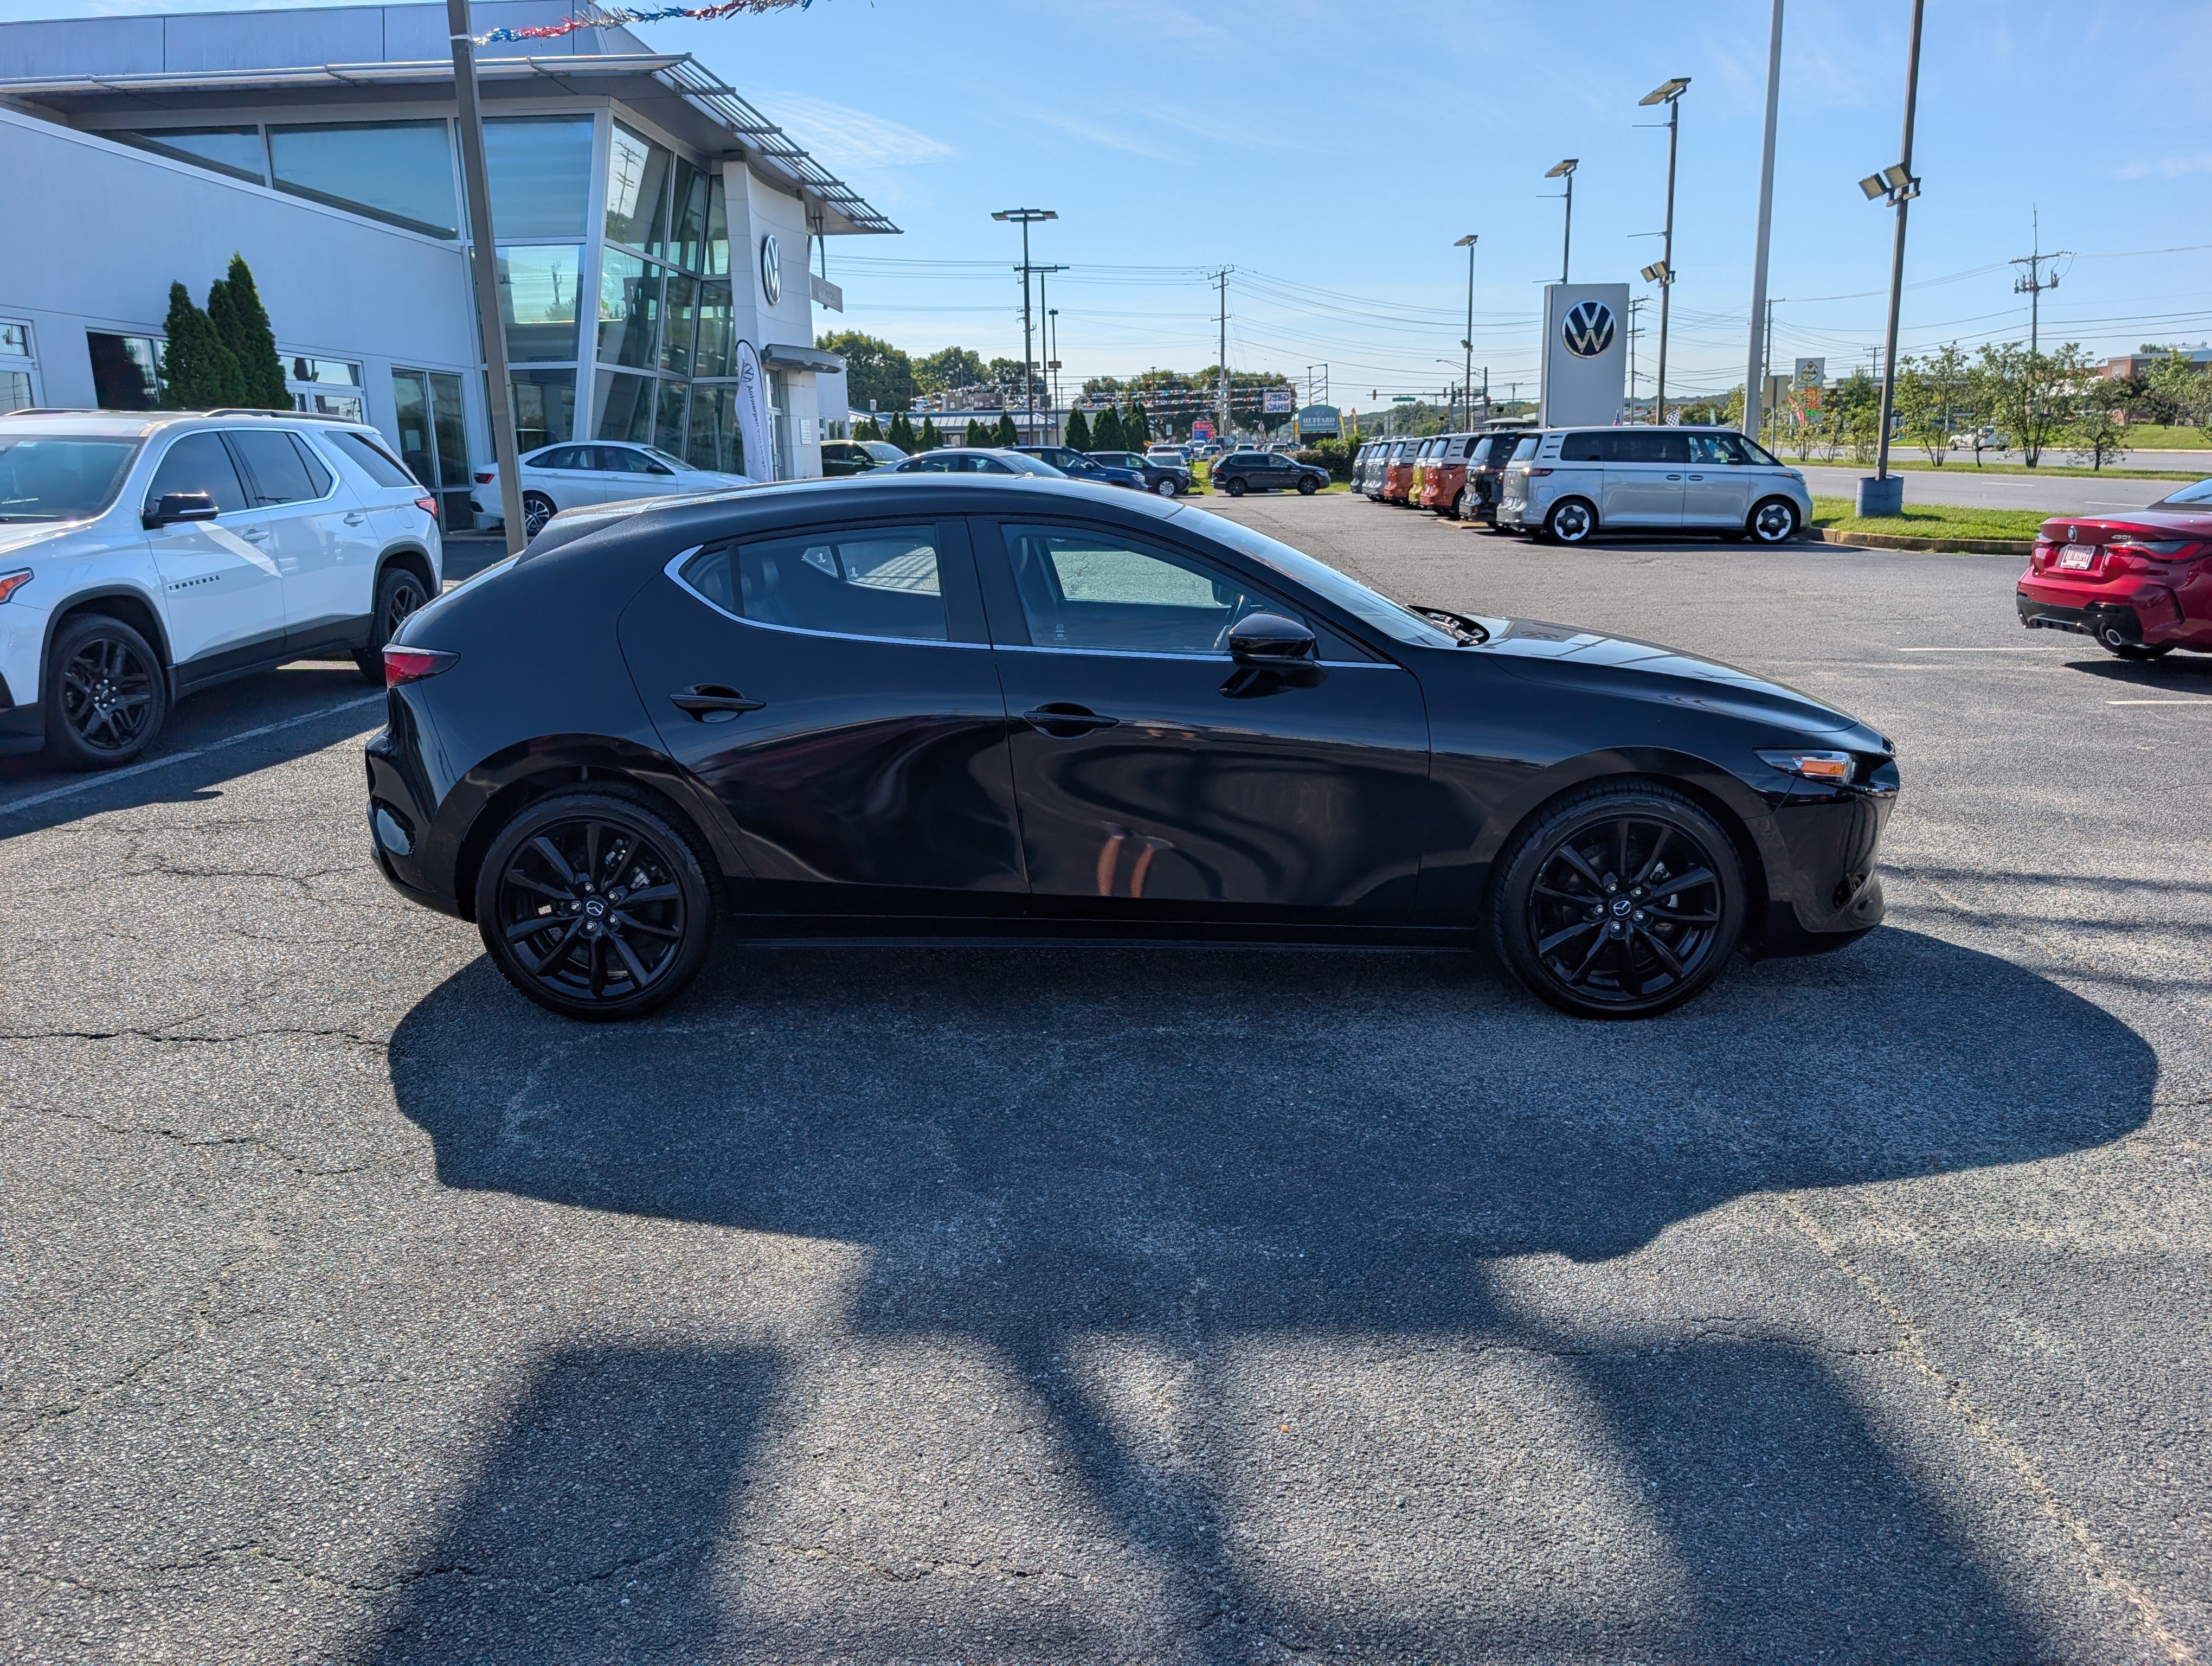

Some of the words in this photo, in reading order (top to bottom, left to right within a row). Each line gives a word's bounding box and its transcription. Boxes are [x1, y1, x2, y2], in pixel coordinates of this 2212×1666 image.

[1562, 300, 1617, 359] VW
[747, 386, 759, 427] Antwerpen
[1266, 403, 1289, 411] CARS
[169, 575, 220, 591] TRAVERSE
